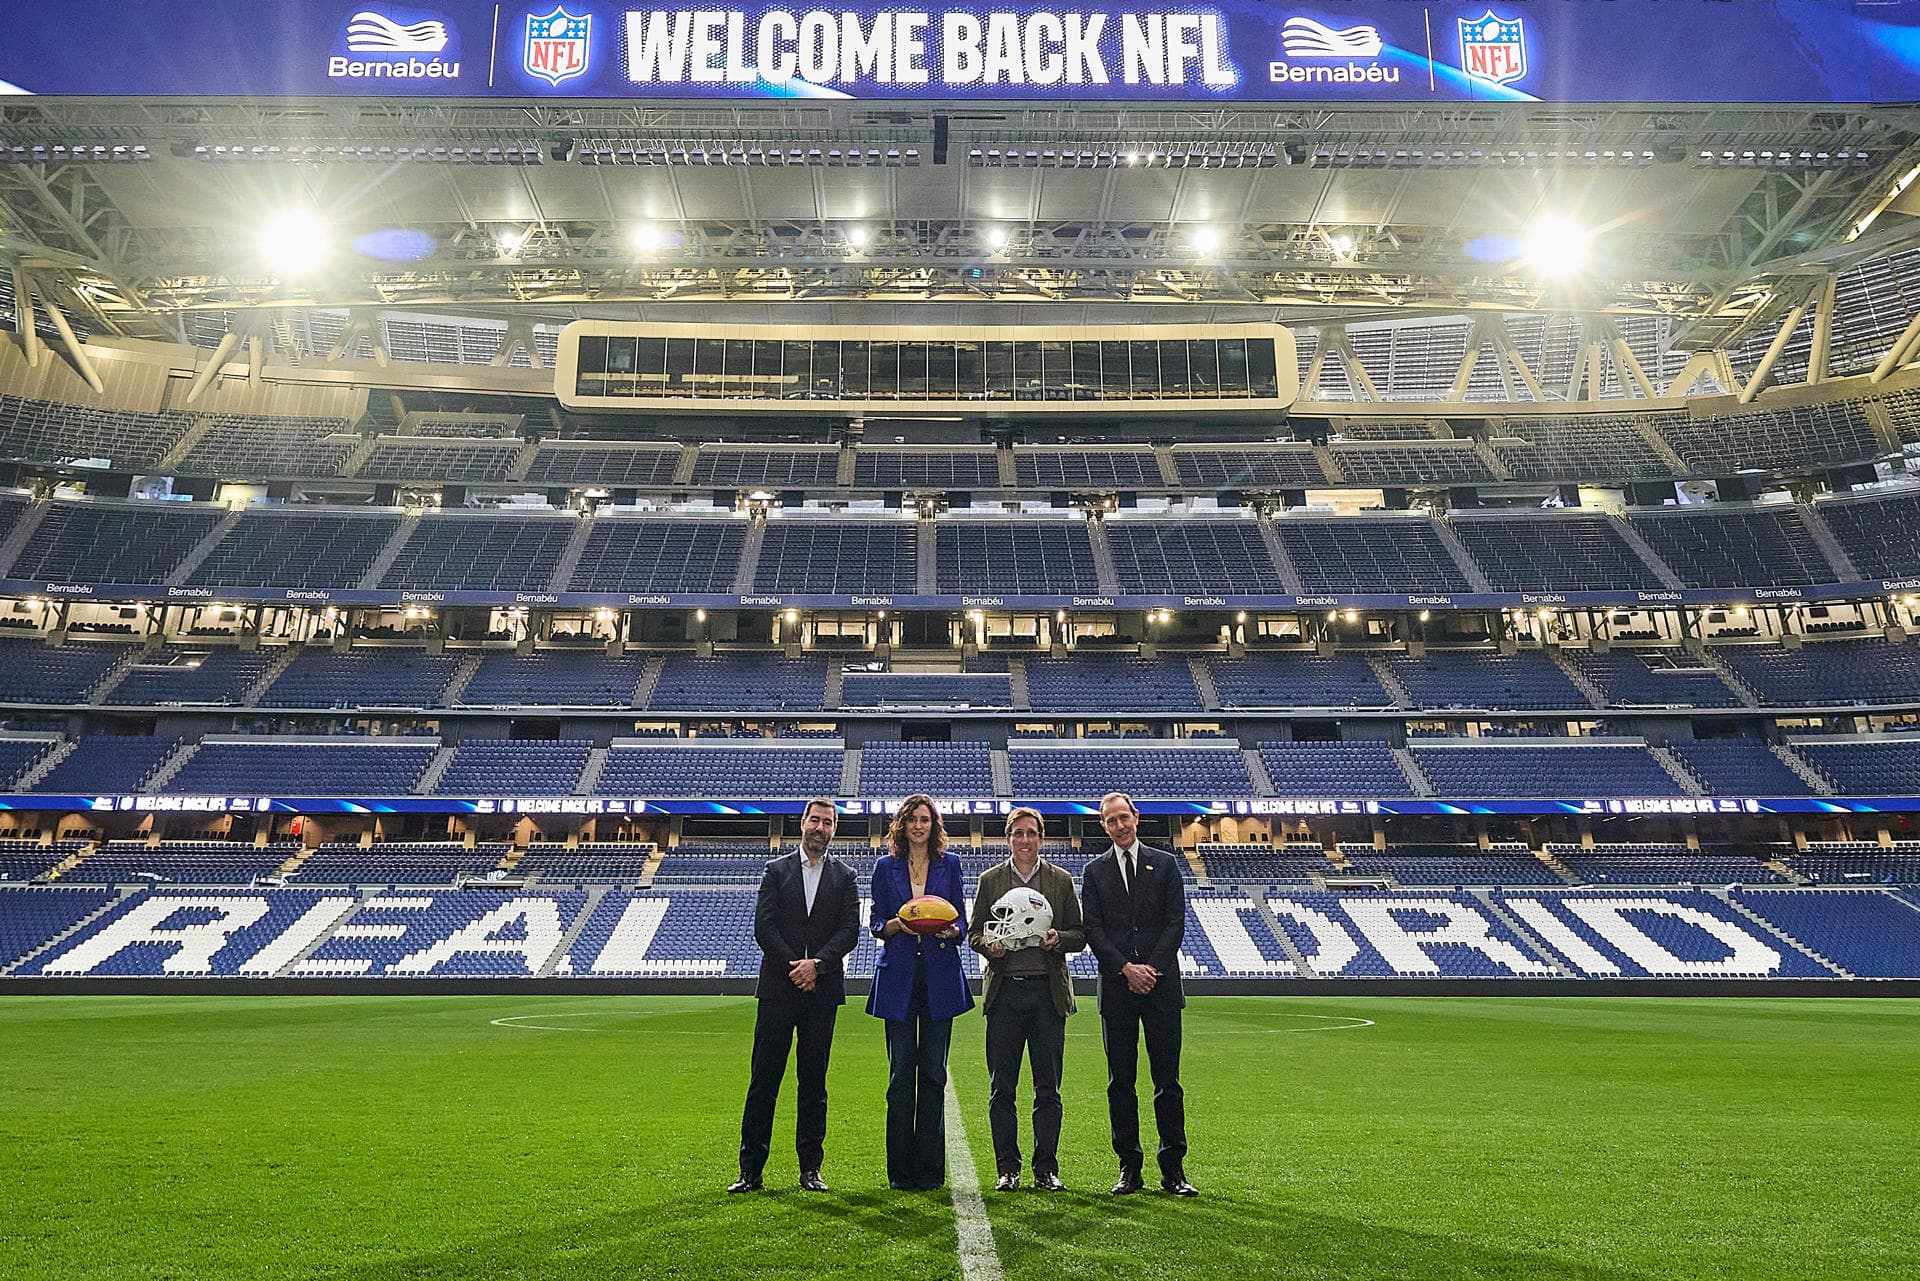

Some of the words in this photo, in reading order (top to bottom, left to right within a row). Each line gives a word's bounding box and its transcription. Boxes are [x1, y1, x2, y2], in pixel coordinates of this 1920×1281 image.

[625, 11, 929, 85] WELCOME
[943, 12, 1110, 85] BACK
[1123, 14, 1235, 86] NFL
[532, 41, 582, 74] NFL
[1469, 44, 1520, 77] NFL
[327, 56, 460, 79] Bernabéu
[1269, 61, 1400, 85] Bernabéu
[46, 582, 94, 595] Bernabéu
[168, 586, 214, 598] Bernabéu
[1755, 587, 1803, 600] Bernabéu
[286, 589, 331, 600] Bernabéu
[402, 591, 446, 602] Bernabéu
[516, 593, 559, 604] Bernabéu
[628, 594, 671, 605] Bernabéu
[1522, 593, 1567, 605] Bernabéu
[1638, 591, 1683, 602] Bernabéu
[740, 595, 783, 606] Bernabéu
[851, 595, 894, 606] Bernabéu
[962, 596, 1005, 607] Bernabéu
[1073, 596, 1115, 607] Bernabéu
[1184, 596, 1227, 607] Bernabéu
[1296, 596, 1339, 606] Bernabéu
[1408, 595, 1452, 606] Bernabéu
[41, 896, 727, 976] REAL
